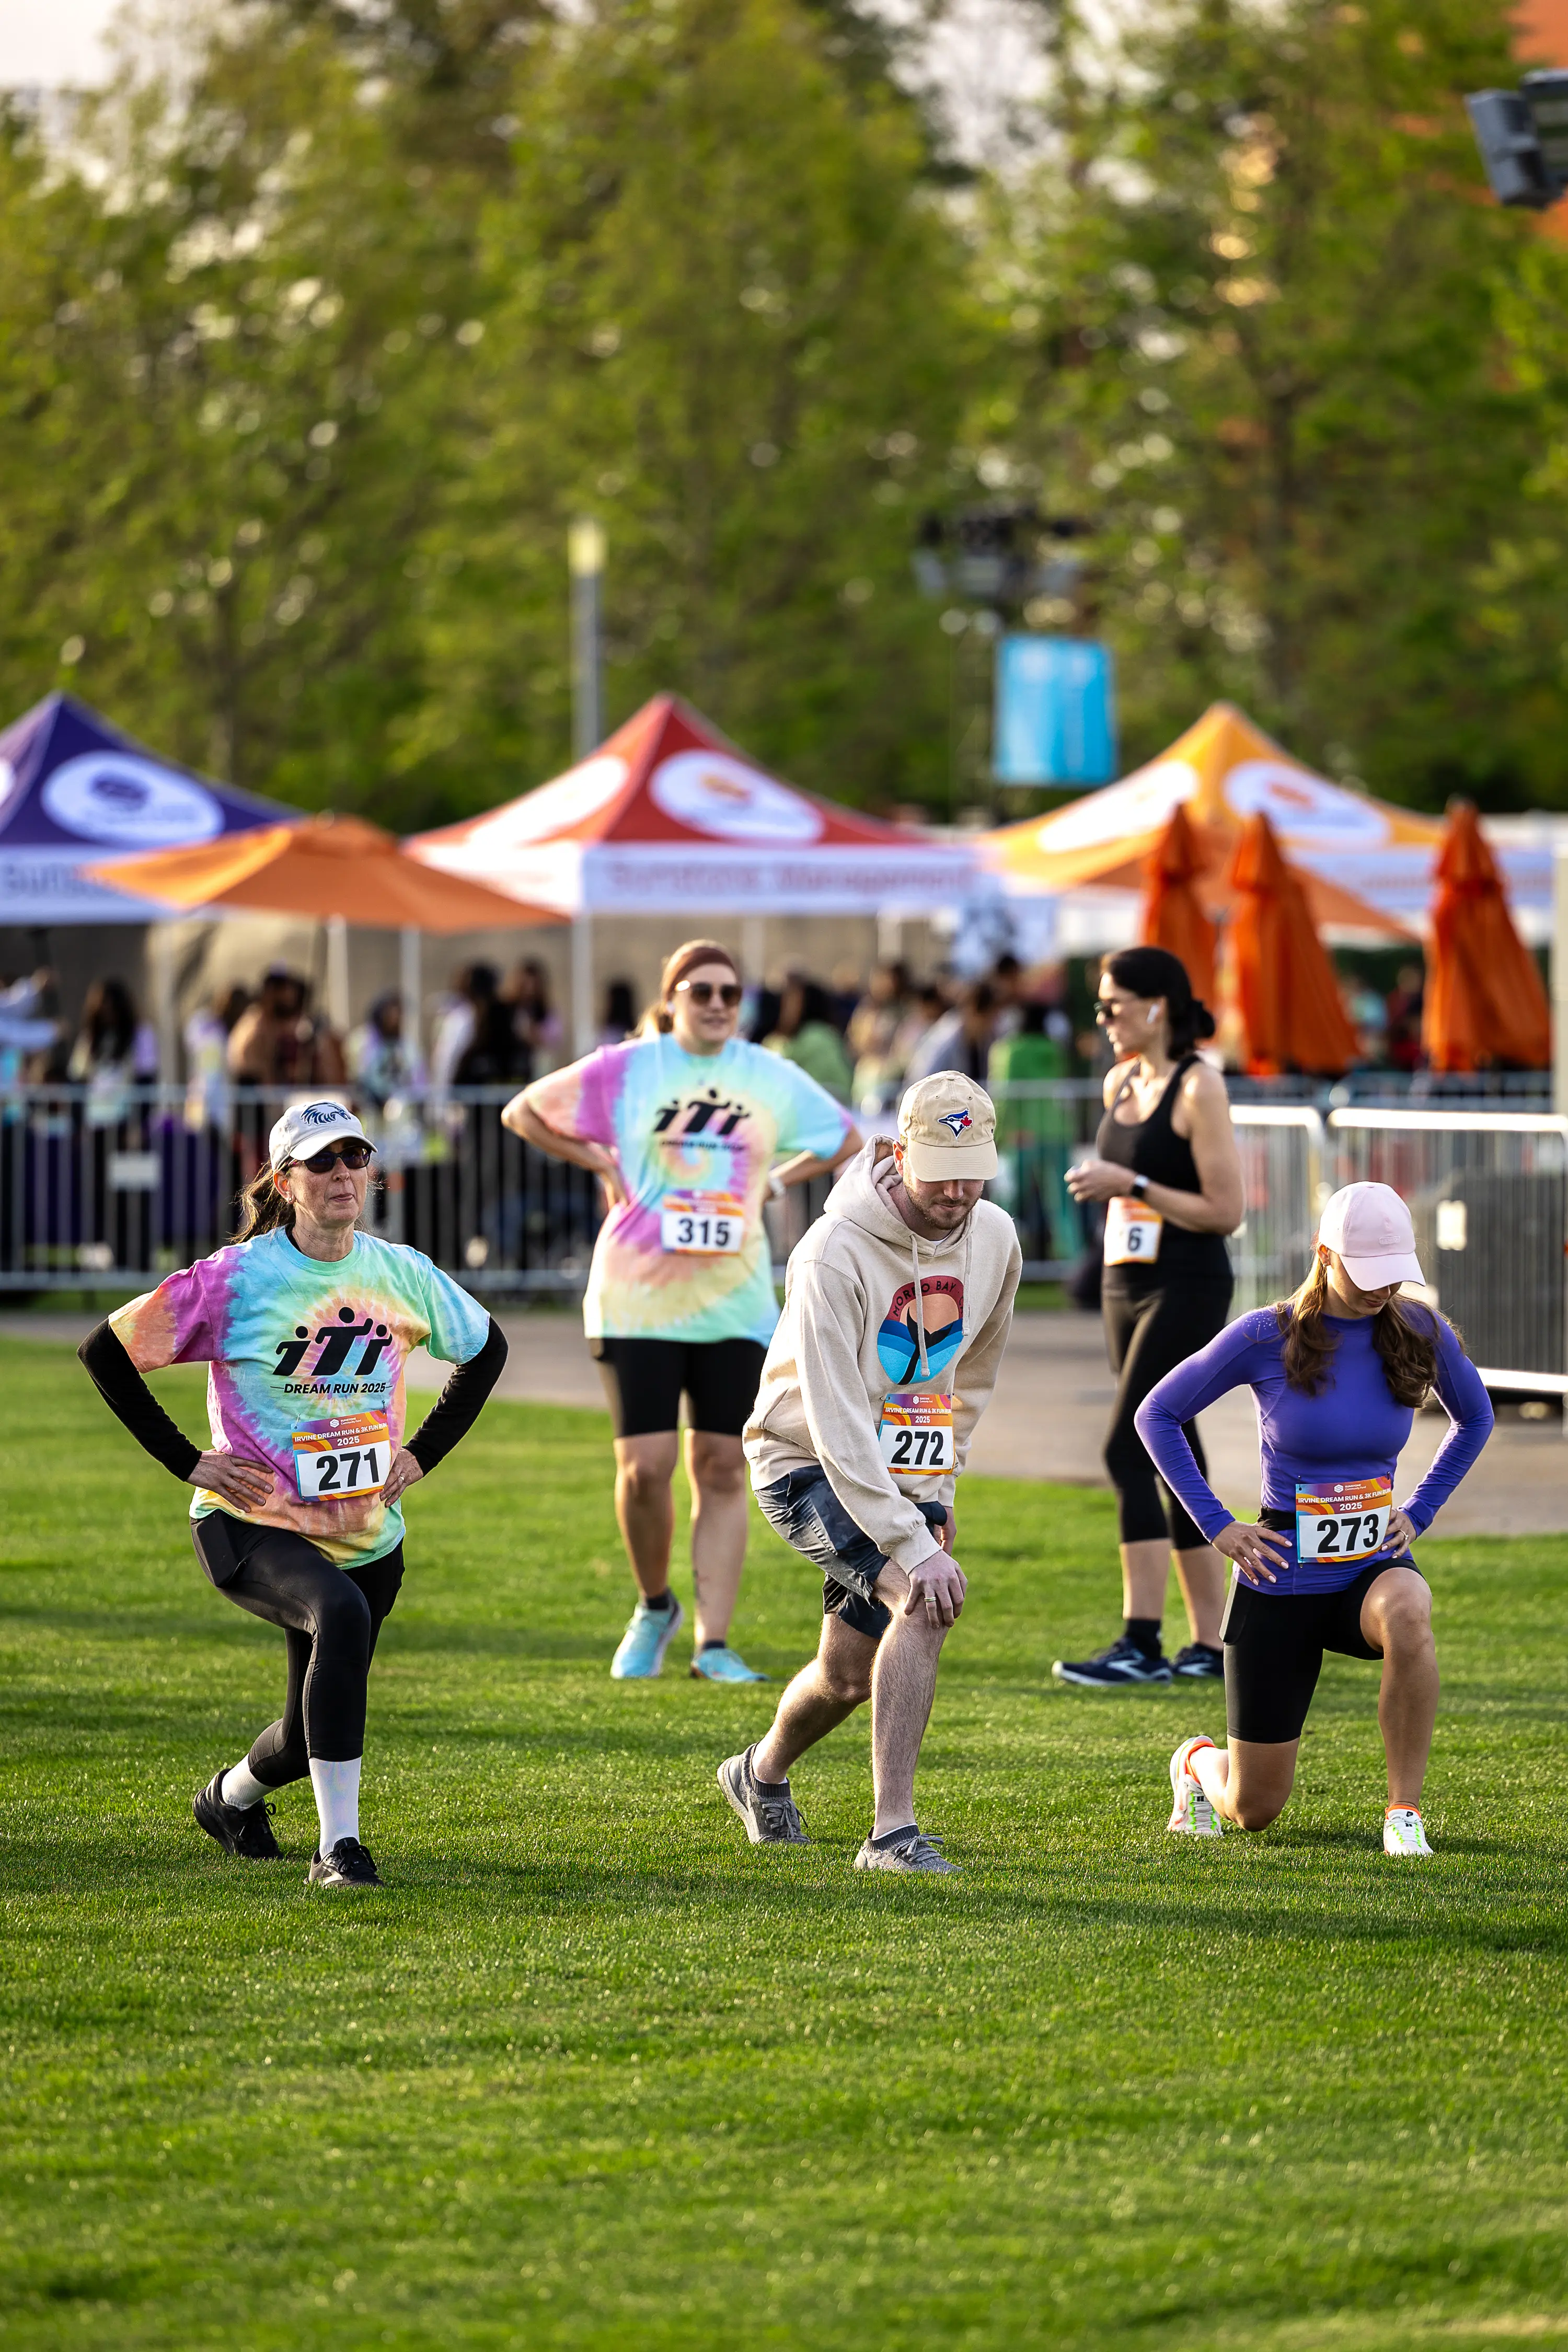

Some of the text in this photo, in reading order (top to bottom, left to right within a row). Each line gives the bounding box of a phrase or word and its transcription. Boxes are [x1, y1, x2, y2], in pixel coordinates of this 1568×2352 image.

[678, 1218, 730, 1247] 315
[936, 1281, 956, 1293] BAY
[284, 1382, 386, 1393] DREAM RUN 2025
[337, 1436, 360, 1446] 2025
[891, 1430, 944, 1466] 272
[316, 1448, 379, 1492] 271
[1340, 1502, 1363, 1511] 2025
[1317, 1514, 1379, 1554] 273
